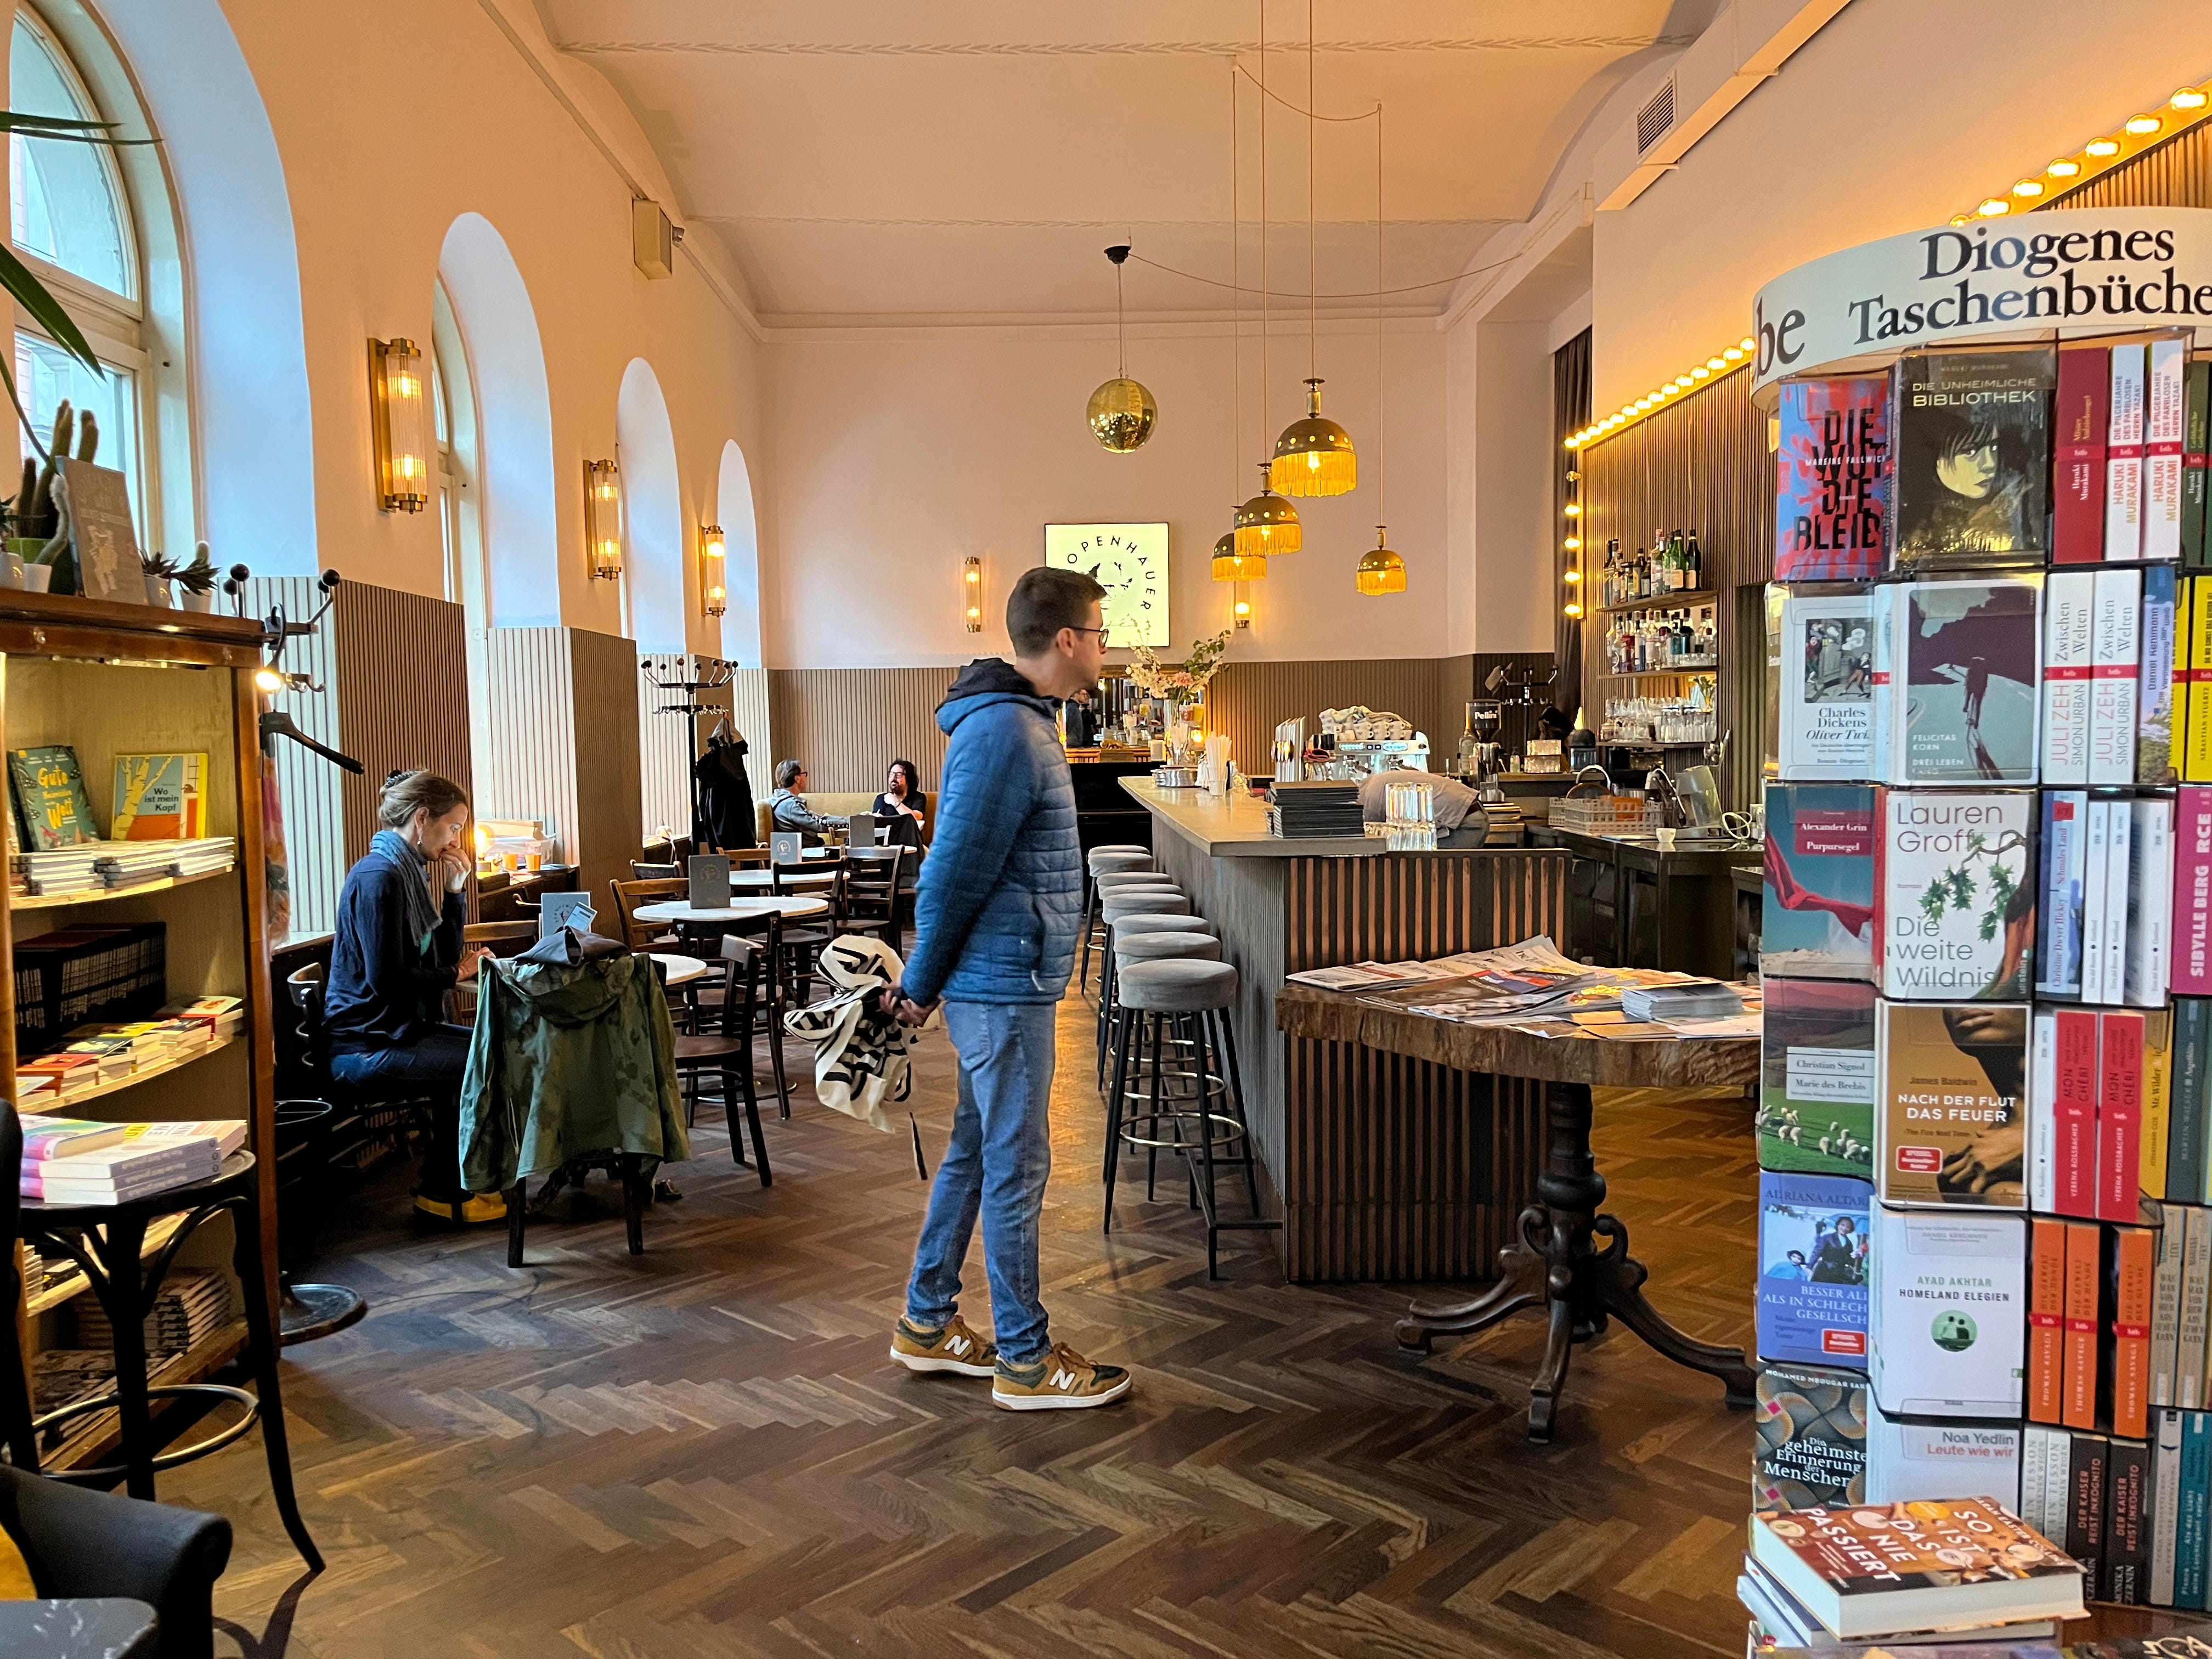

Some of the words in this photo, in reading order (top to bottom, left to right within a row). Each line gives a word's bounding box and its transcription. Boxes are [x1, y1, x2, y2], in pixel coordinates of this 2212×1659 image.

[1919, 227, 2175, 280] Diogenes
[1942, 379, 2036, 390] UNHEIMLICHE
[1913, 391, 2036, 407] BIBLIOTHEK
[2114, 376, 2123, 426] PILGERJAHRE
[2153, 372, 2161, 424] PILGERJAHRE
[2113, 464, 2125, 505] HARUKI
[2153, 461, 2164, 502] HARUKI
[2166, 460, 2177, 521] MURAKAMI
[2126, 464, 2137, 524] MURAKAMI
[2055, 601, 2070, 662] Zwischen
[2073, 609, 2088, 654] Welten
[2100, 600, 2115, 660] Zwischen
[2117, 606, 2133, 652] Welten
[1819, 707, 1866, 718] Charles
[2052, 685, 2069, 721] ZEH
[2072, 684, 2085, 724] URBAN
[2096, 684, 2115, 720] ZEH
[2117, 683, 2130, 723] URBAN
[1475, 710, 1498, 719] Pellini
[1818, 718, 1866, 727] Dickens
[1807, 730, 1843, 740] Oliver
[1846, 730, 1870, 740] Twi
[2051, 727, 2069, 765] JULI
[2071, 727, 2084, 765] SIMON
[2095, 727, 2114, 765] JULI
[2115, 726, 2129, 765] SIMON
[154, 787, 168, 795] Wo
[155, 803, 176, 812] Kopf
[1897, 803, 2003, 824] Lauren
[1807, 841, 1860, 853] Purpursegel
[1897, 829, 1978, 853] Groff
[2059, 828, 2067, 850] Land
[2057, 851, 2066, 885] Schmales
[2194, 865, 2209, 908] BERG
[1897, 917, 1939, 936] Die
[1897, 940, 1973, 960] weite
[2191, 912, 2207, 977] SIBYLLE
[1897, 967, 1995, 988] Wildnis
[1797, 1059, 1836, 1070] Christian
[1838, 1062, 1865, 1071] Signol
[1796, 1079, 1820, 1087] Marie
[1838, 1081, 1866, 1090] Brebis
[1909, 1076, 1938, 1085] James
[1942, 1077, 1977, 1086] Baldwin
[1898, 1094, 1939, 1104] NACH
[1944, 1096, 1973, 1105] DER
[1979, 1097, 2016, 1107] FLUT
[1907, 1108, 1942, 1120] DAS
[1949, 1109, 2007, 1122] FEUER
[1801, 1286, 1843, 1299] BESSER
[1917, 1276, 1945, 1285] AYAD
[1949, 1277, 1992, 1286] AKHTAR
[1763, 1294, 1785, 1304] ALS
[1790, 1296, 1803, 1306] IN
[1899, 1289, 1960, 1300] HOMELAND
[1964, 1293, 2010, 1301] ELEGIEN
[1765, 1369, 1808, 1381] MOHAMED
[1808, 1377, 1848, 1387] MBOUGAR
[1809, 1437, 1827, 1446] Die
[1927, 1443, 1965, 1455] Leute
[1968, 1447, 1990, 1457] wie
[1993, 1447, 2015, 1457] wir
[1943, 1432, 1969, 1443] Noa
[1974, 1433, 2014, 1445] Yedlin
[1776, 1449, 1862, 1475] Erinnerung
[1784, 1440, 1867, 1462] geheimste
[1804, 1464, 1820, 1472] der
[2079, 1470, 2089, 1506] KAISER
[2090, 1458, 2101, 1513] INKOGNITO
[2117, 1477, 2127, 1514] KAISER
[2128, 1464, 2139, 1521] INKOGNITO
[1953, 1510, 1993, 1533] SO
[1999, 1515, 2031, 1539] EASTER
[2078, 1509, 2087, 1529] DER
[2089, 1516, 2098, 1544] REIST
[2116, 1515, 2125, 1537] DER
[1798, 1508, 1902, 1582] PASSIERT
[1888, 1519, 1942, 1551] DAS
[1937, 1528, 1985, 1553] IST
[2126, 1523, 2136, 1551] REIST
[1869, 1534, 1918, 1563] NIE
